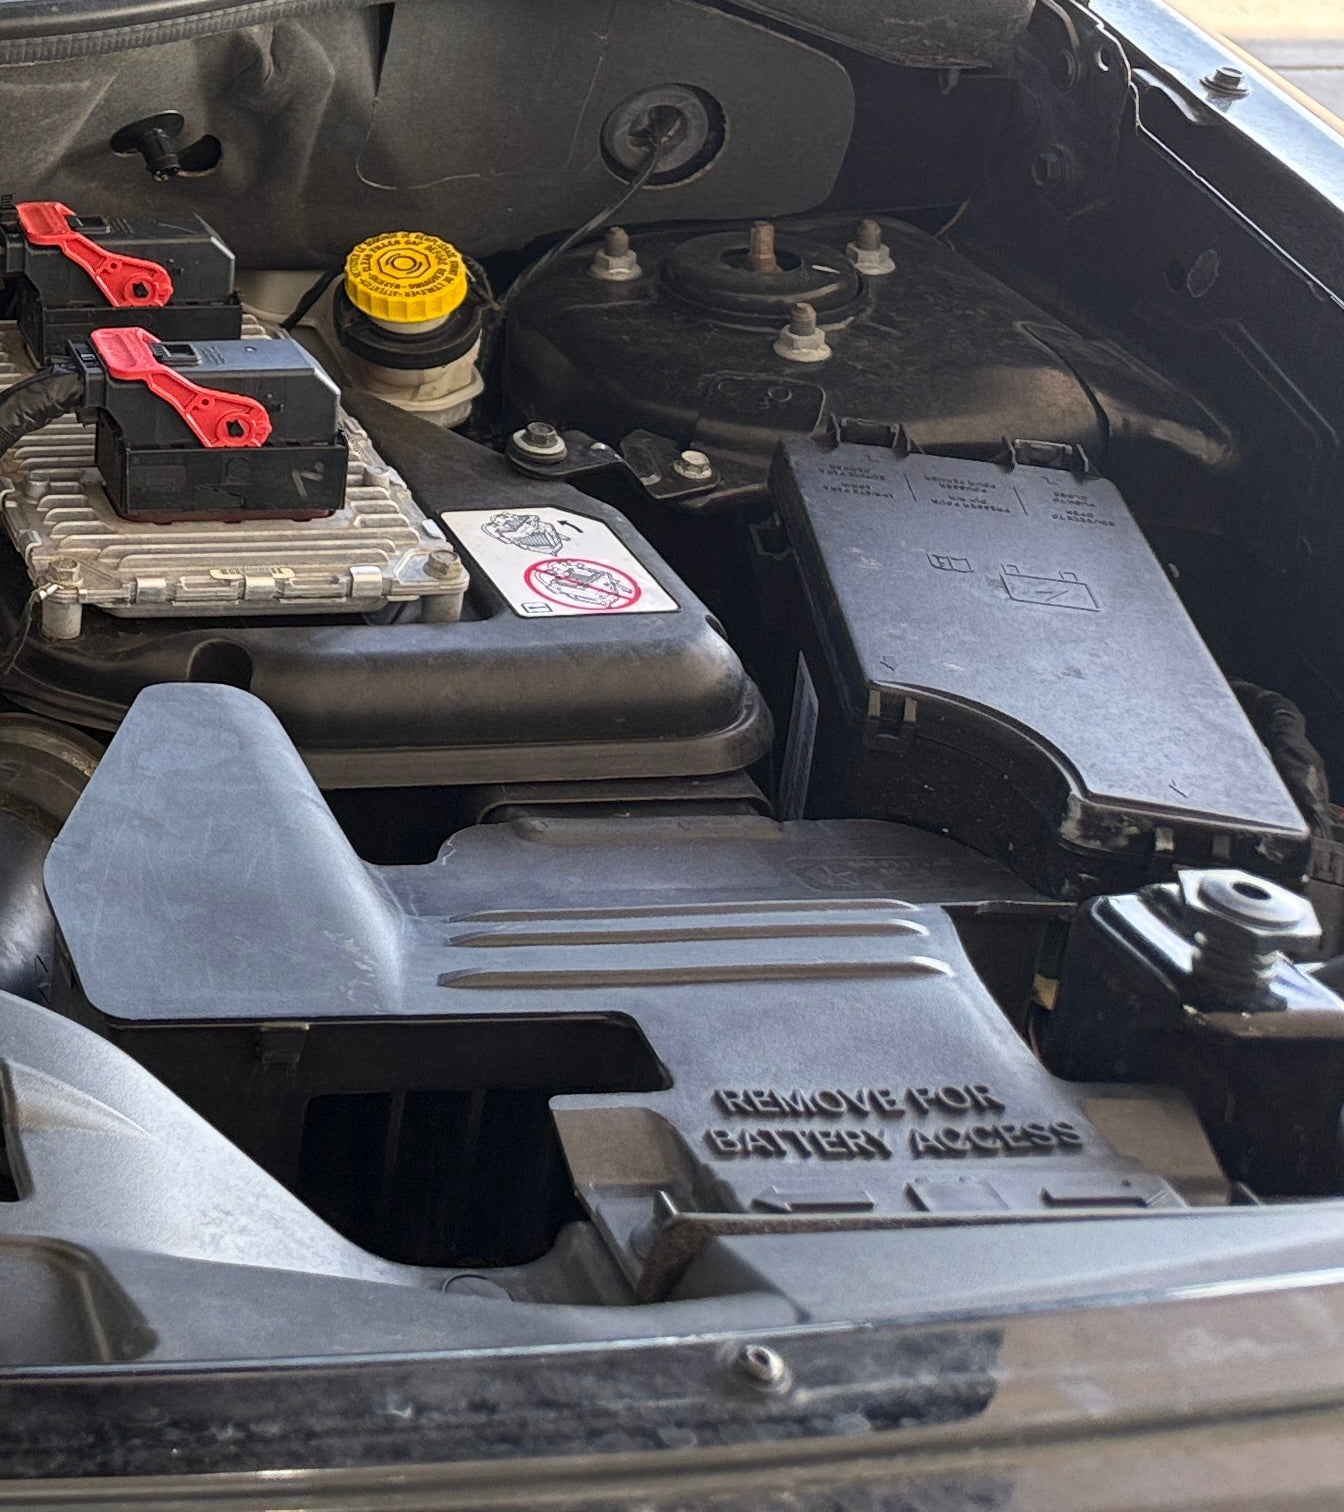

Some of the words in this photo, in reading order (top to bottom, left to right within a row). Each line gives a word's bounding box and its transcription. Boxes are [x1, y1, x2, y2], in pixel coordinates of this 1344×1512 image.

[713, 1087, 906, 1118] REMOVE
[906, 1084, 1006, 1114] FOR
[704, 1127, 893, 1160] BATTERY
[908, 1120, 1083, 1159] ACCESS
